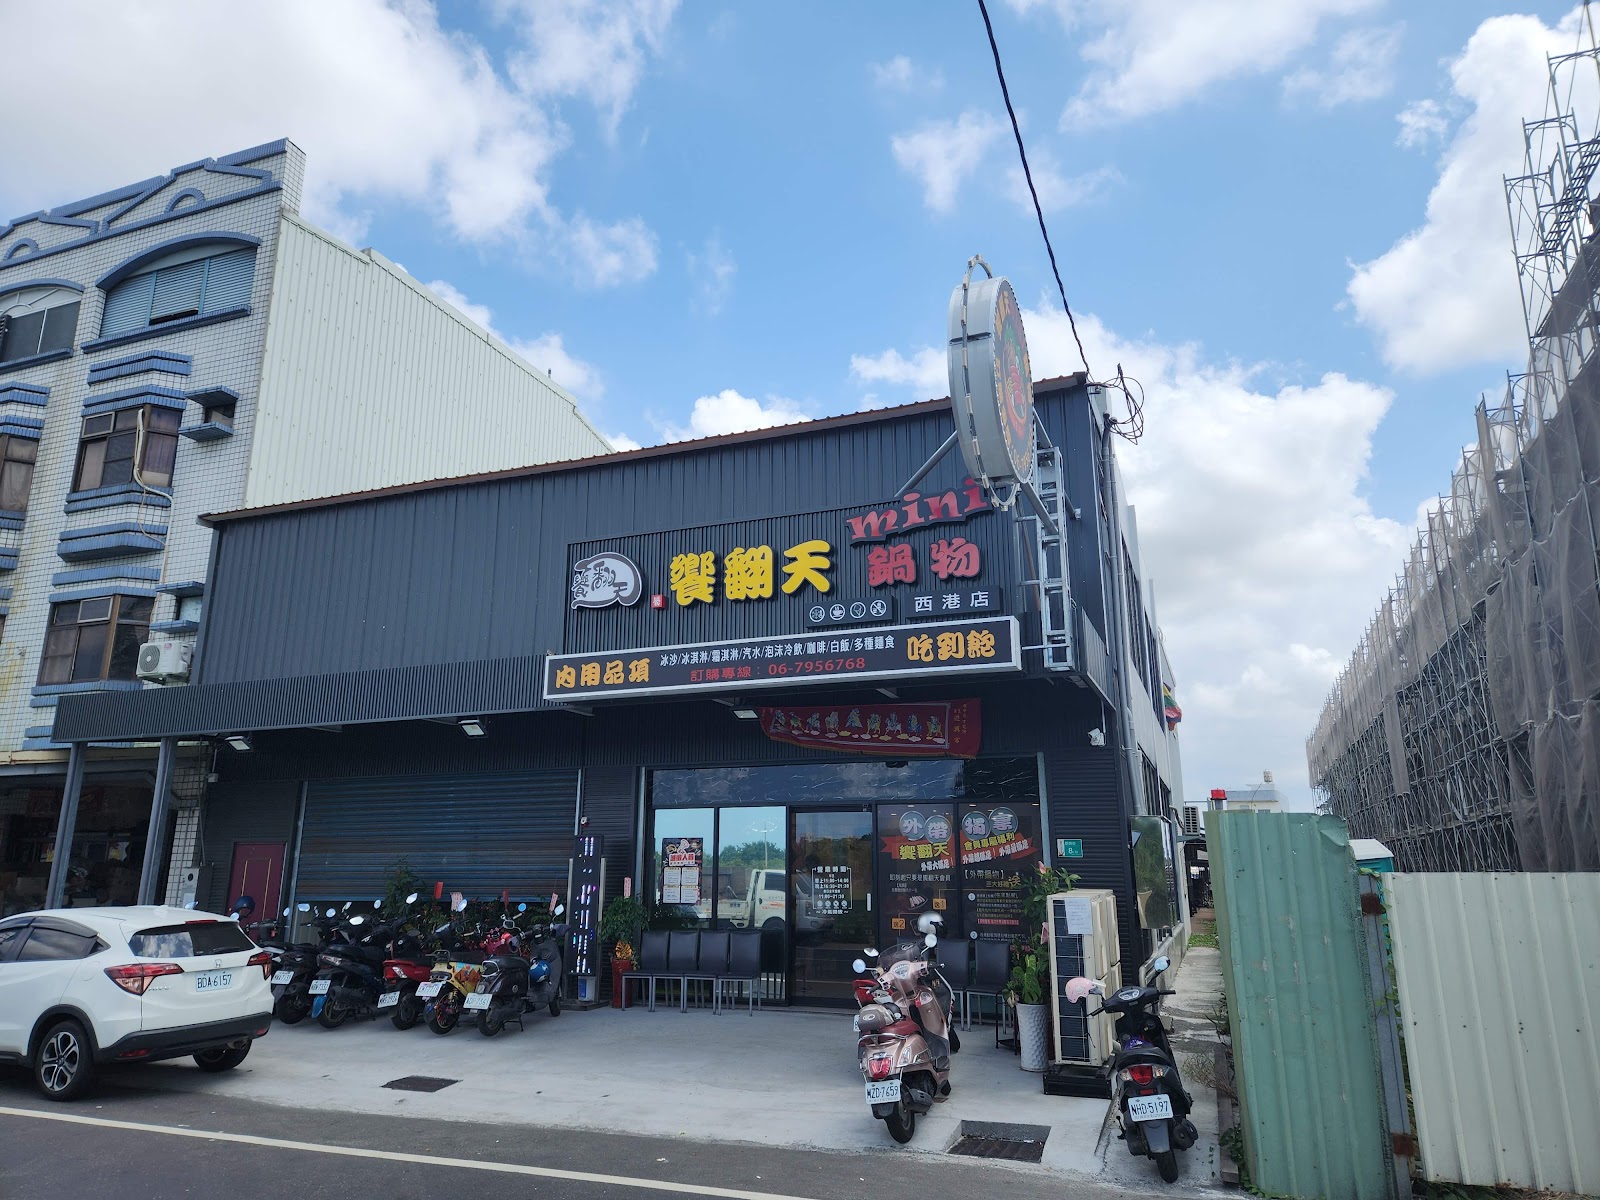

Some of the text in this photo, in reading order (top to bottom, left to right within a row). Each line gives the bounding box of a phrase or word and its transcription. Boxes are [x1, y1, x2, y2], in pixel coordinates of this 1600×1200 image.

[847, 478, 987, 540] mini
[670, 540, 831, 606] 饗翻天
[868, 537, 980, 586] 鍋物
[914, 590, 989, 613] 西港店
[907, 629, 996, 662] 吃到飽
[555, 658, 650, 689] 內用品項
[768, 657, 866, 676] 06-7956768
[899, 842, 950, 860] 饗翻天
[197, 974, 232, 989] BDA-6157
[1131, 1101, 1168, 1115] NHD-5197
